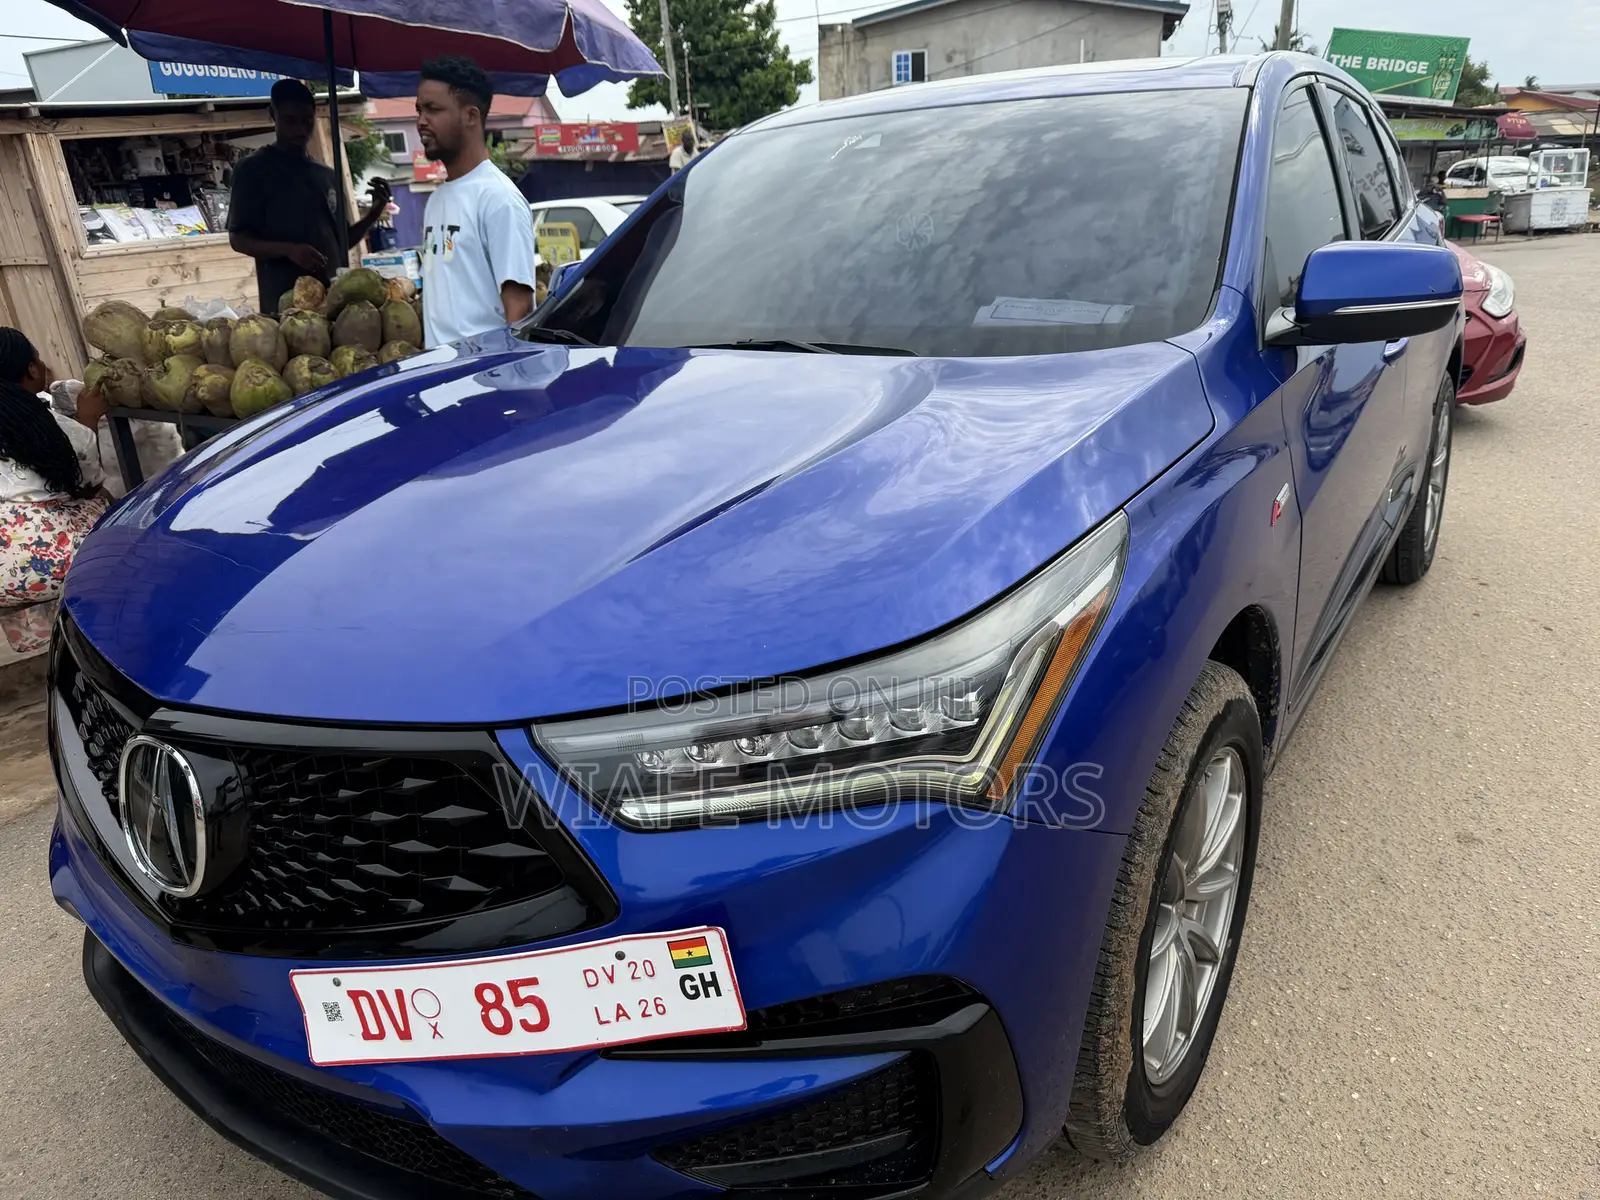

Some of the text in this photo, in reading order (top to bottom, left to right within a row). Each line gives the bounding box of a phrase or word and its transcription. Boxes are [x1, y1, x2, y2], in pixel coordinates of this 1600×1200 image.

[1330, 54, 1429, 75] THE BRIDGE
[582, 959, 656, 988] DV 20
[679, 971, 722, 1000] GH
[346, 988, 412, 1041] DV
[474, 976, 550, 1036] 85
[594, 996, 667, 1025] LA 26
